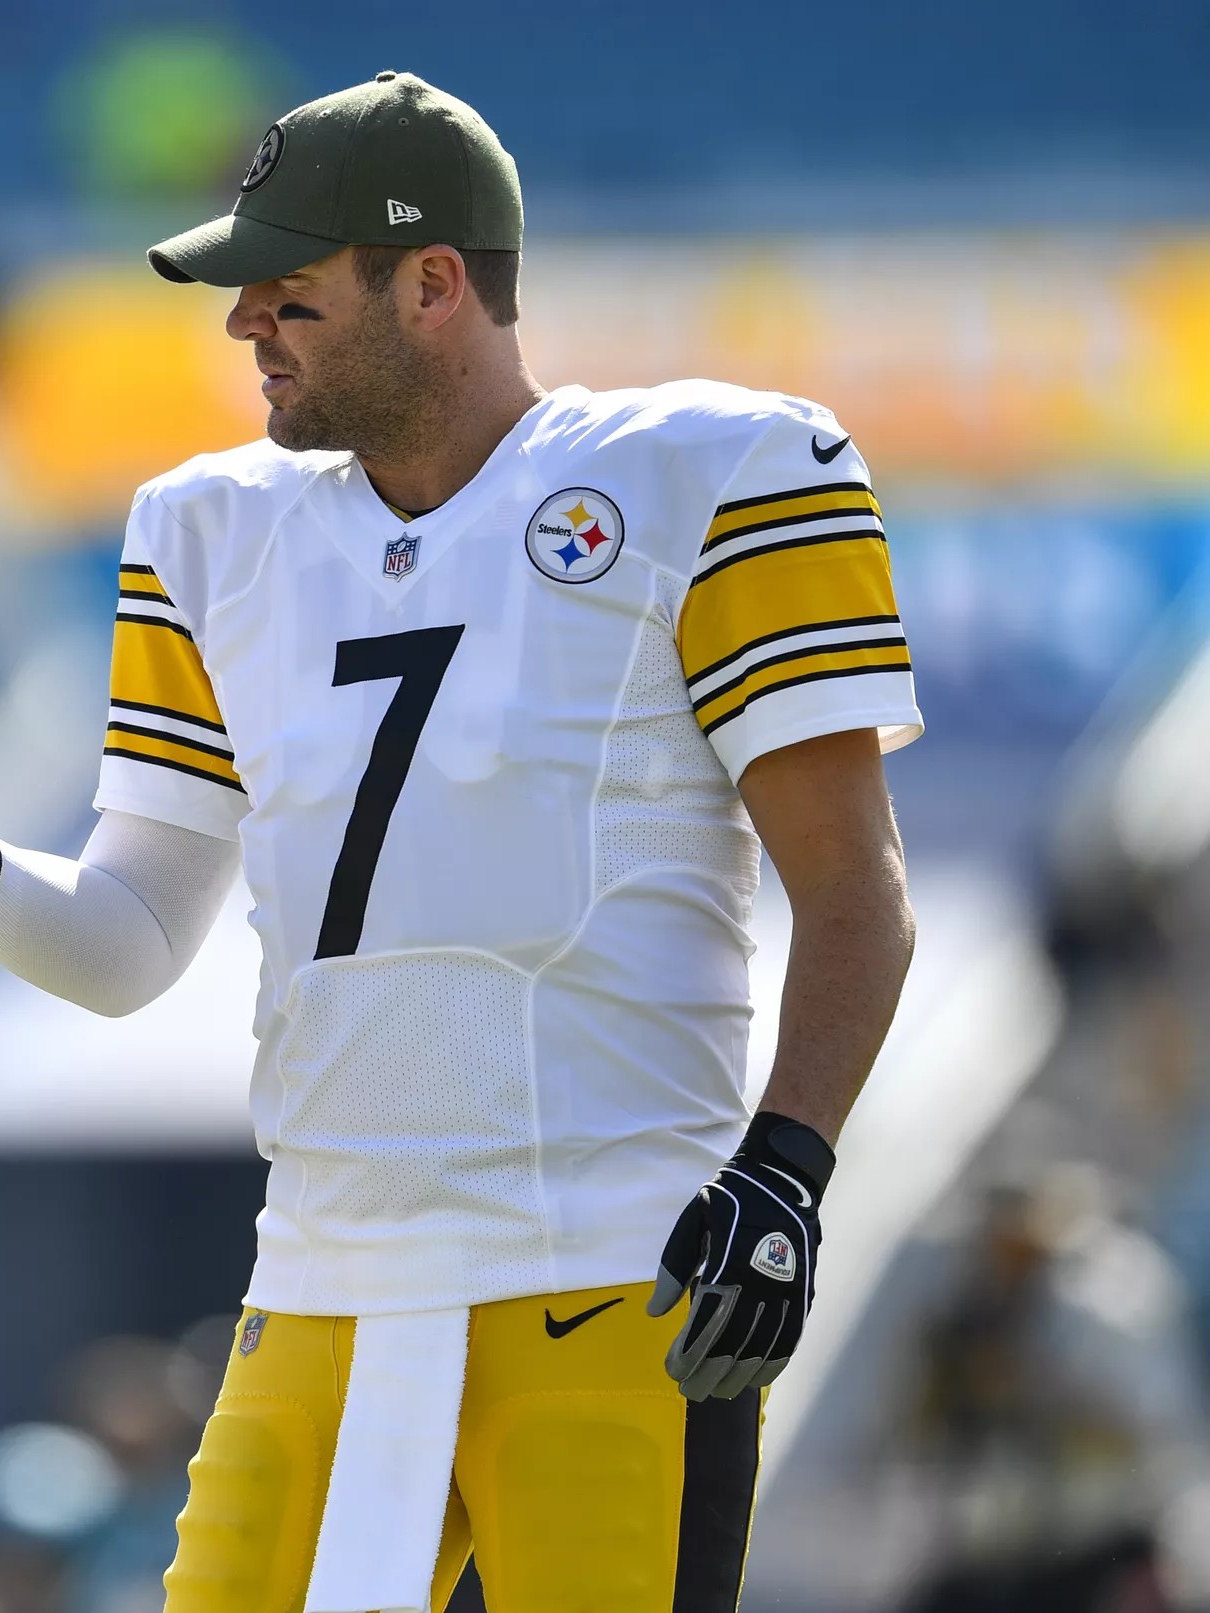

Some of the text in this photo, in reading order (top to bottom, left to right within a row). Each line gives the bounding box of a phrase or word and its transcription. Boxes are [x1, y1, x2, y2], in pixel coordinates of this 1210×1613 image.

[537, 523, 573, 537] Steelers
[387, 552, 411, 571] NFL
[313, 624, 466, 960] 7
[771, 1241, 788, 1256] NFL
[242, 1330, 257, 1348] NFL
